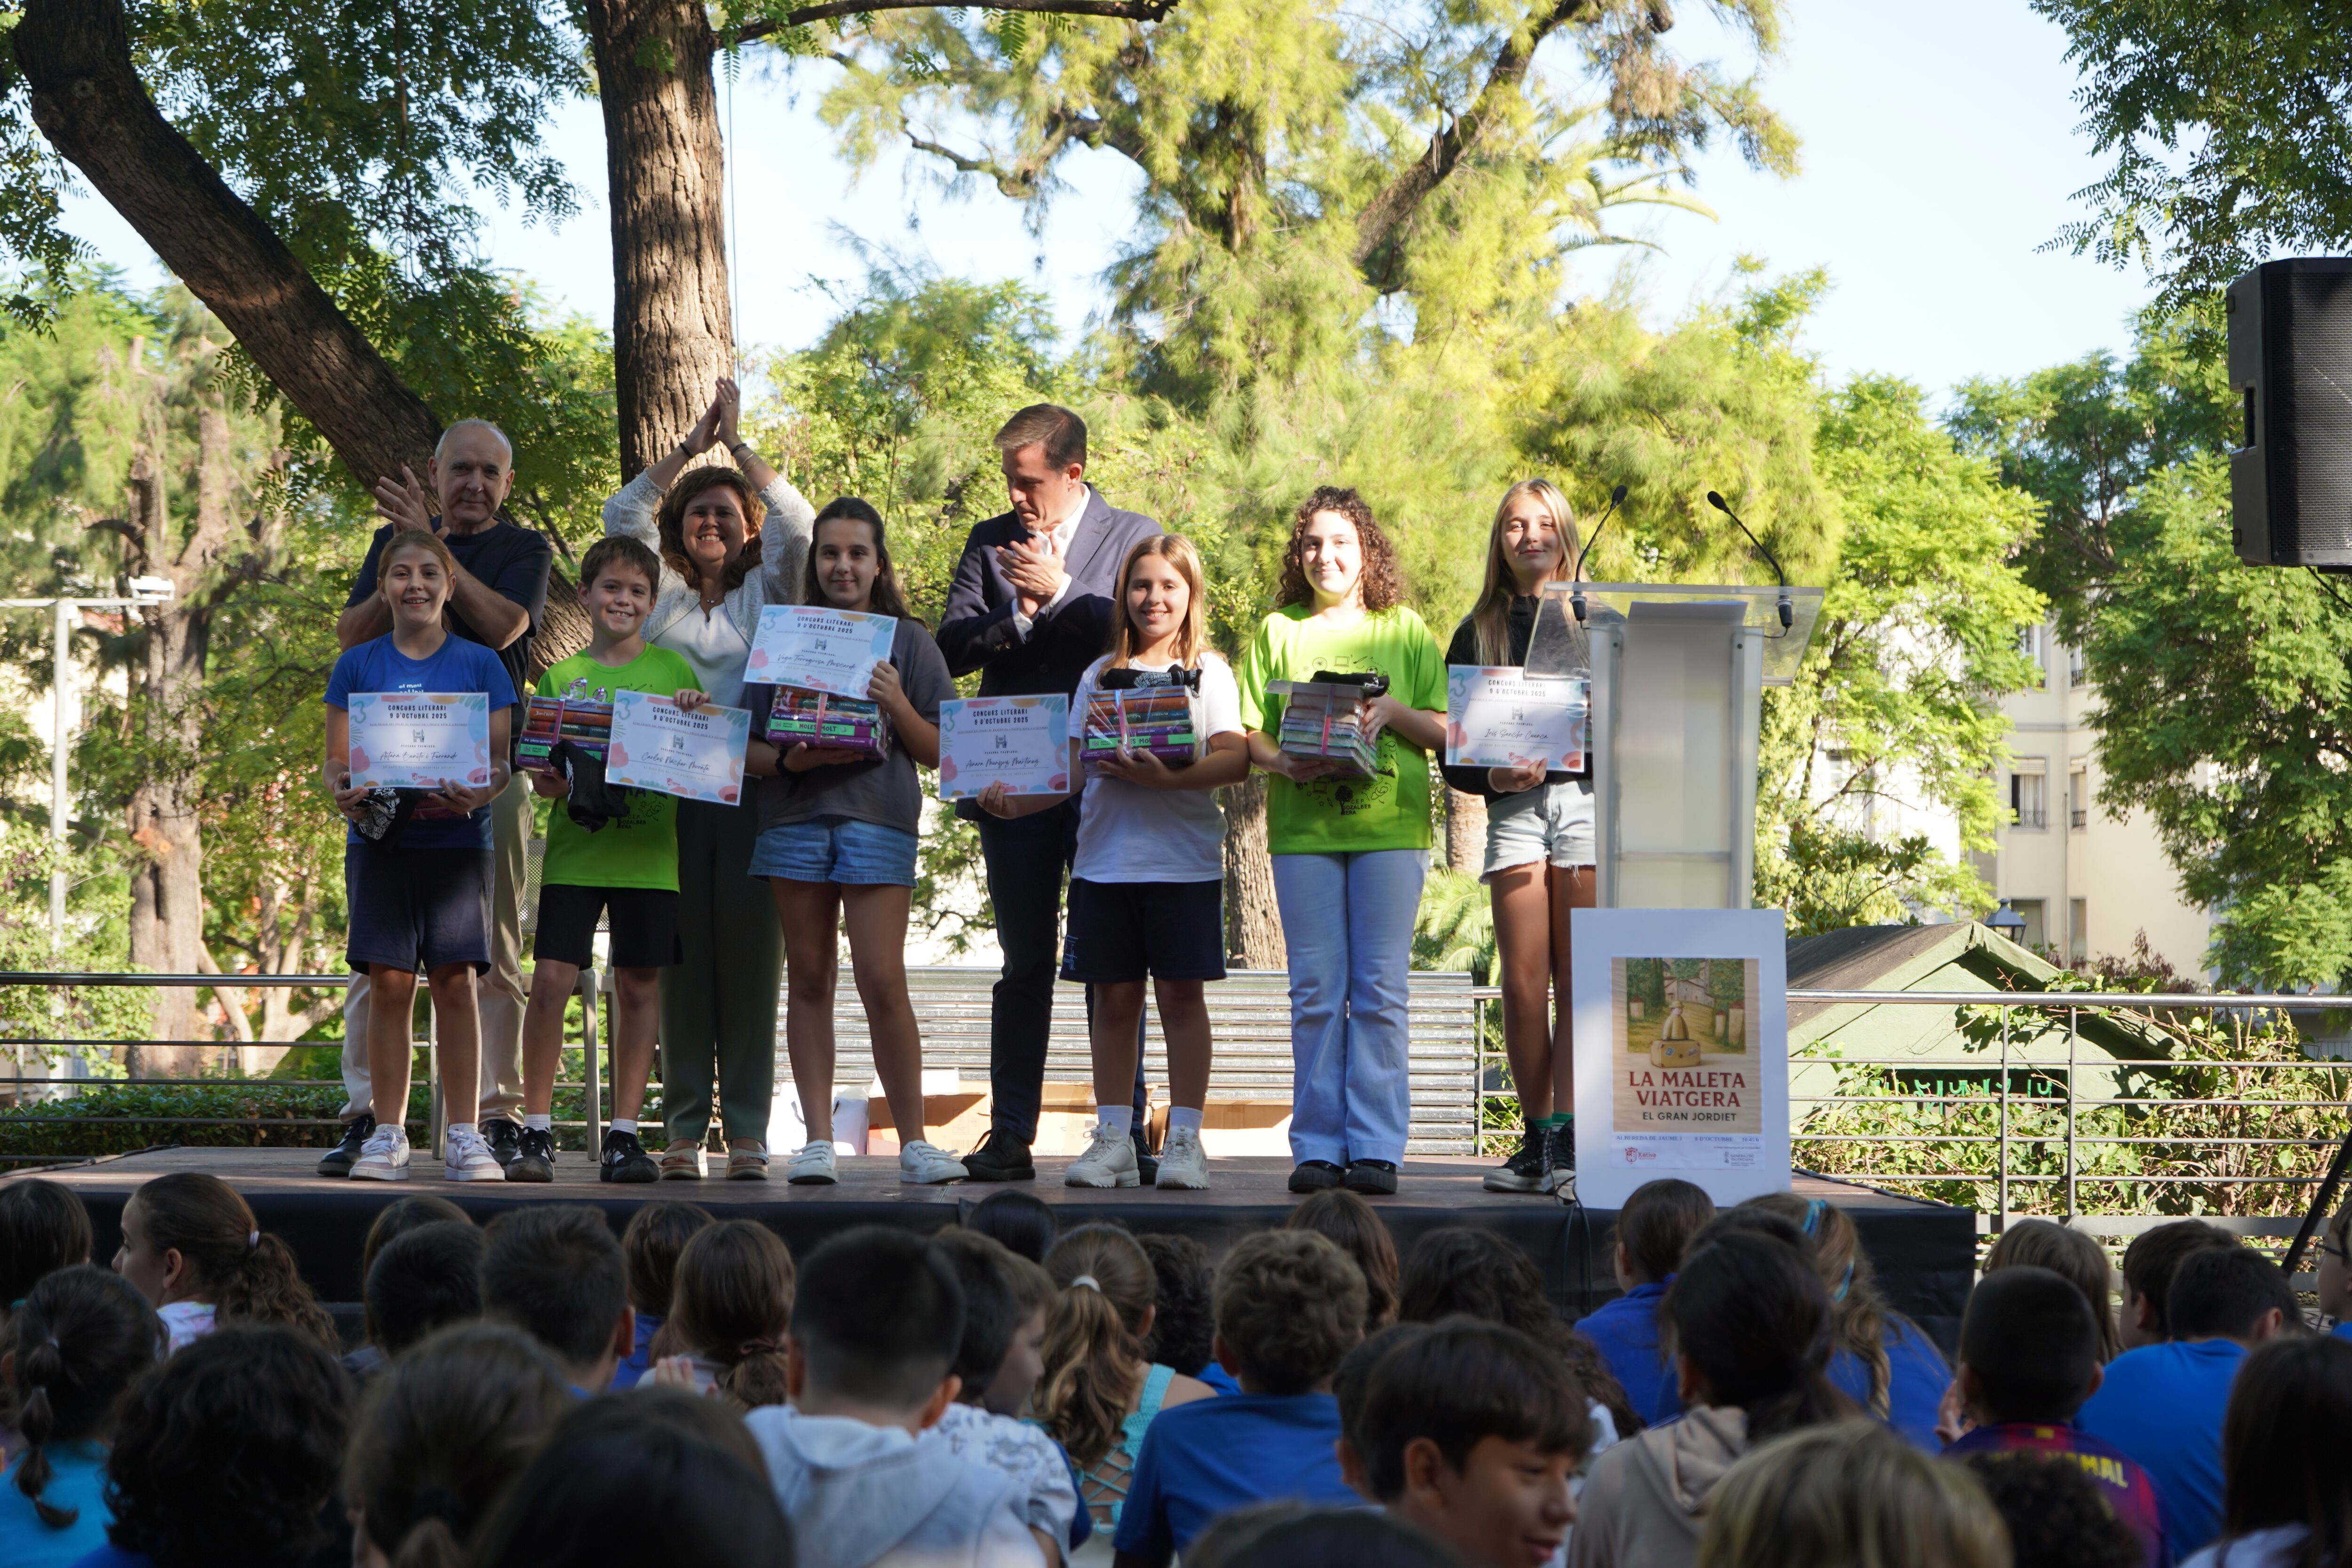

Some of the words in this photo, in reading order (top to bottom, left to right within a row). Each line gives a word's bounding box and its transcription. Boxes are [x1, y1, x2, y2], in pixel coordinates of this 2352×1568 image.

[803, 622, 835, 632] D'OCTUBRE
[826, 618, 854, 627] LITERARI
[653, 707, 679, 716] CONCURS
[682, 711, 708, 721] LITERARI
[660, 716, 691, 727] D'OCTUBRE
[1629, 1071, 1654, 1087] LA
[1662, 1072, 1746, 1088] MALETA
[1636, 1090, 1741, 1107] VIATGERA
[1658, 1112, 1688, 1121] GRAN
[1692, 1113, 1737, 1121] JORDIET
